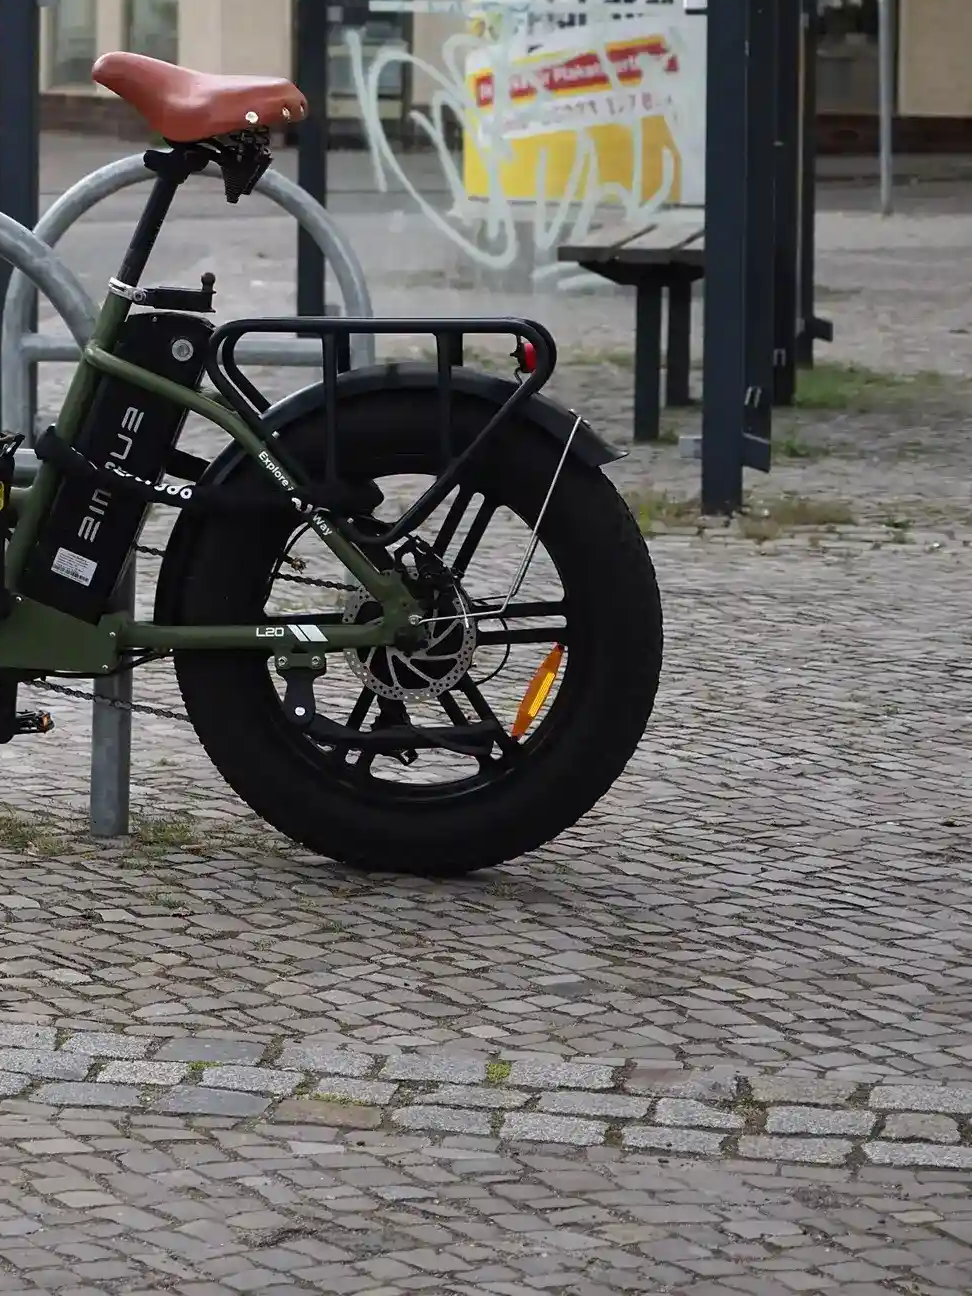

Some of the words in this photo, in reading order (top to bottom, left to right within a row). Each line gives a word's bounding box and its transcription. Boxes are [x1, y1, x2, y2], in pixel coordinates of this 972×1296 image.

[258, 450, 289, 487] Explore
[312, 512, 333, 536] Way
[255, 627, 285, 638] L20
